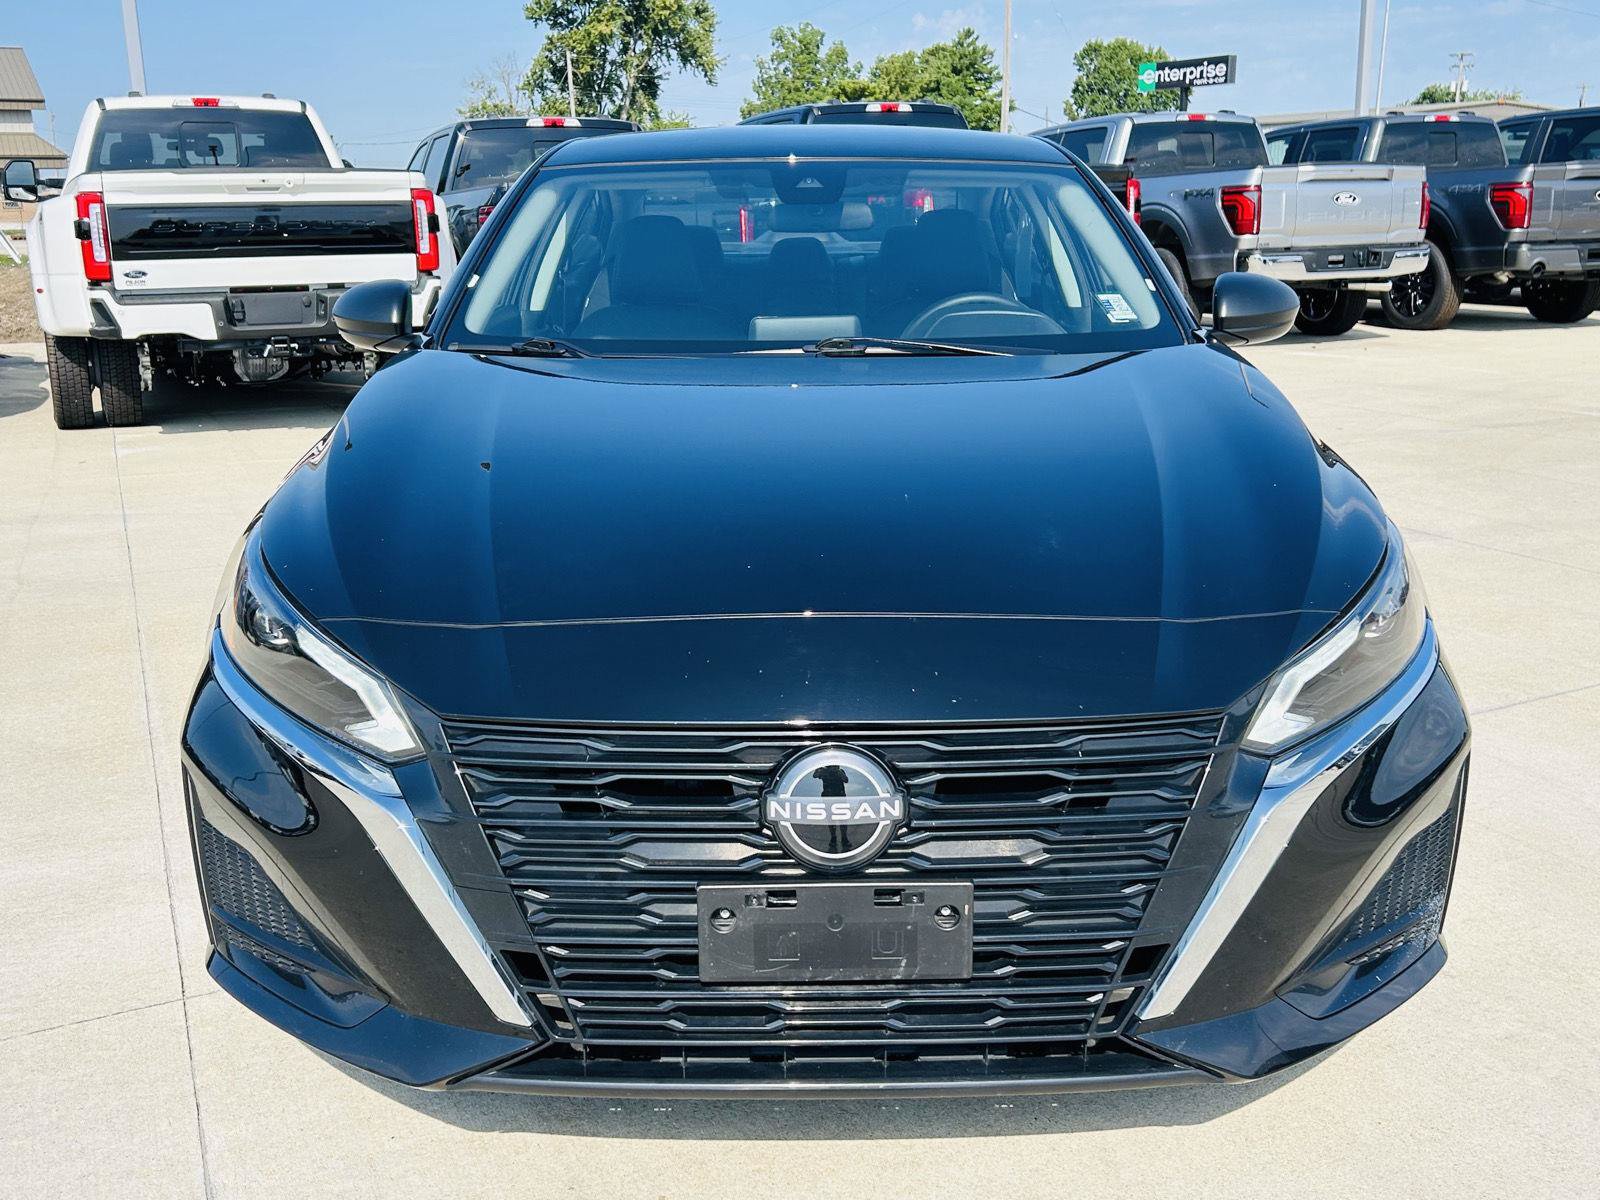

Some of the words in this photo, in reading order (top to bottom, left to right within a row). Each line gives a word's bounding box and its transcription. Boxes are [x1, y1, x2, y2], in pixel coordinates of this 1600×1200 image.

[1138, 61, 1227, 85] enterprise
[1184, 188, 1214, 201] FX4
[152, 219, 278, 233] SUPER
[286, 218, 376, 232] DUTY
[769, 799, 901, 821] NISSAN
